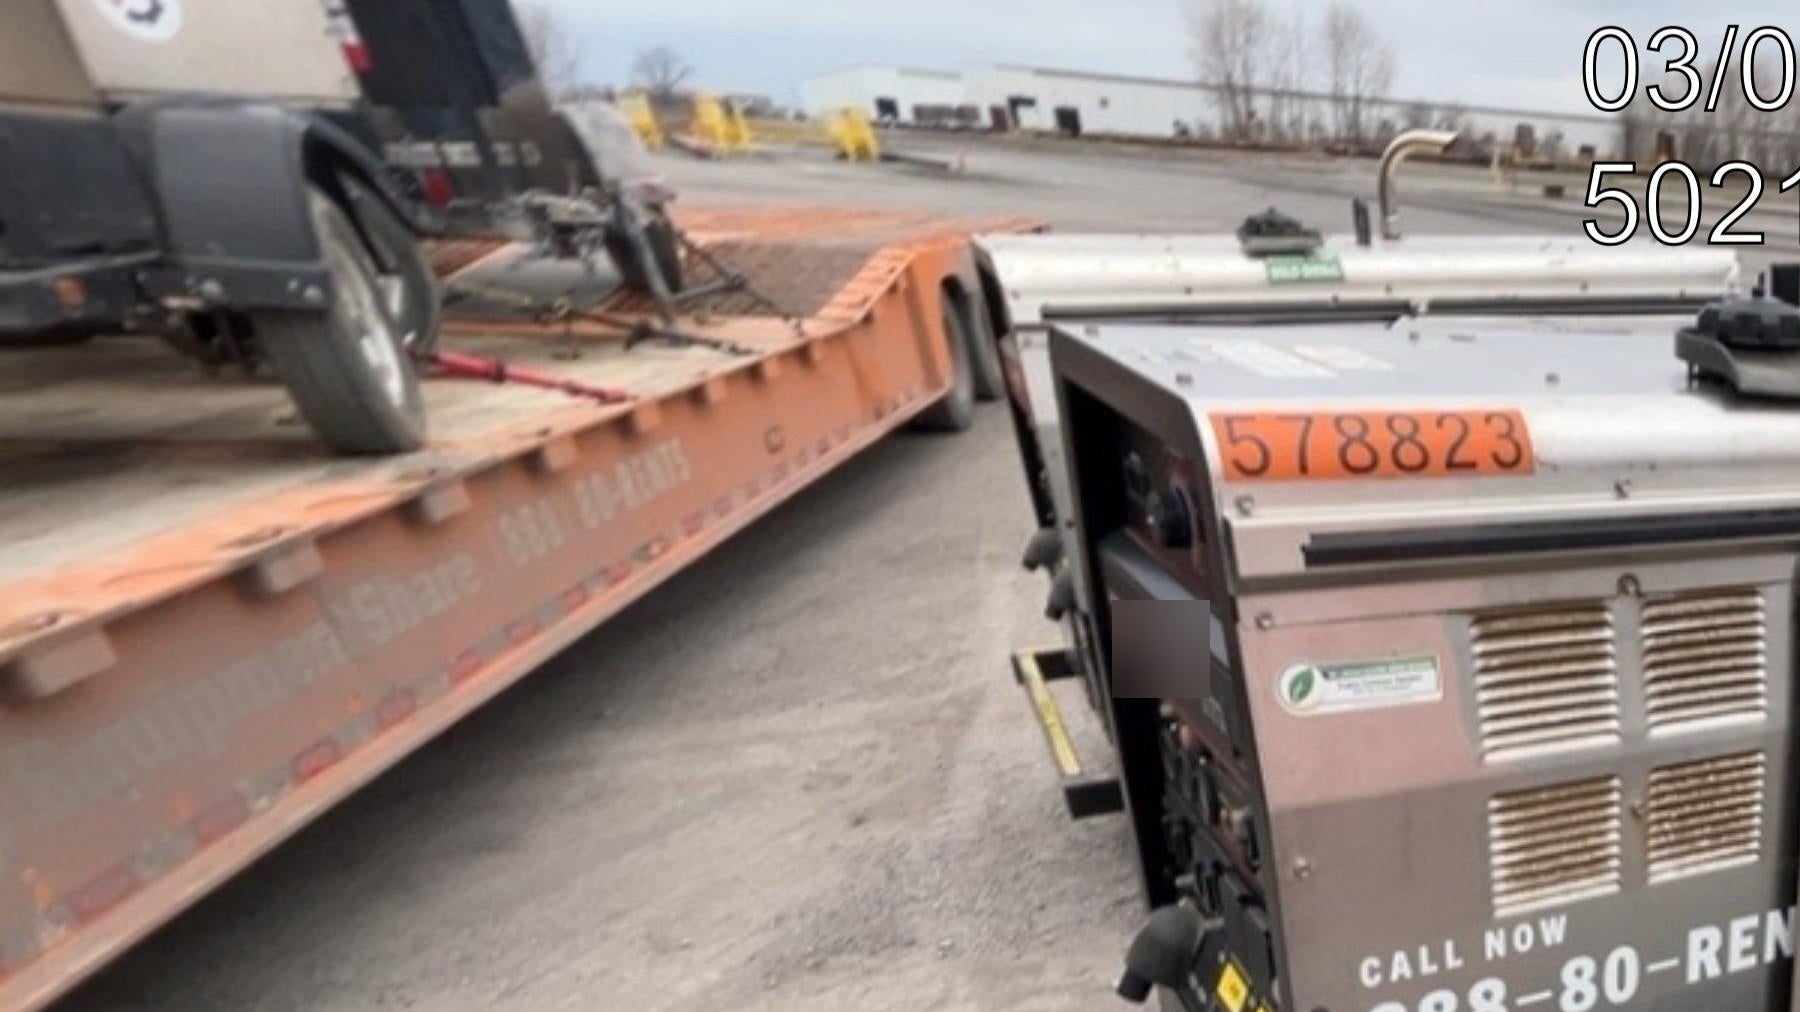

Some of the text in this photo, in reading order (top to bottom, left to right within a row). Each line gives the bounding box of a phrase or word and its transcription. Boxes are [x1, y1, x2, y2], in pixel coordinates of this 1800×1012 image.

[1223, 411, 1523, 476] 578823
[1359, 915, 1569, 988] CALL NOW
